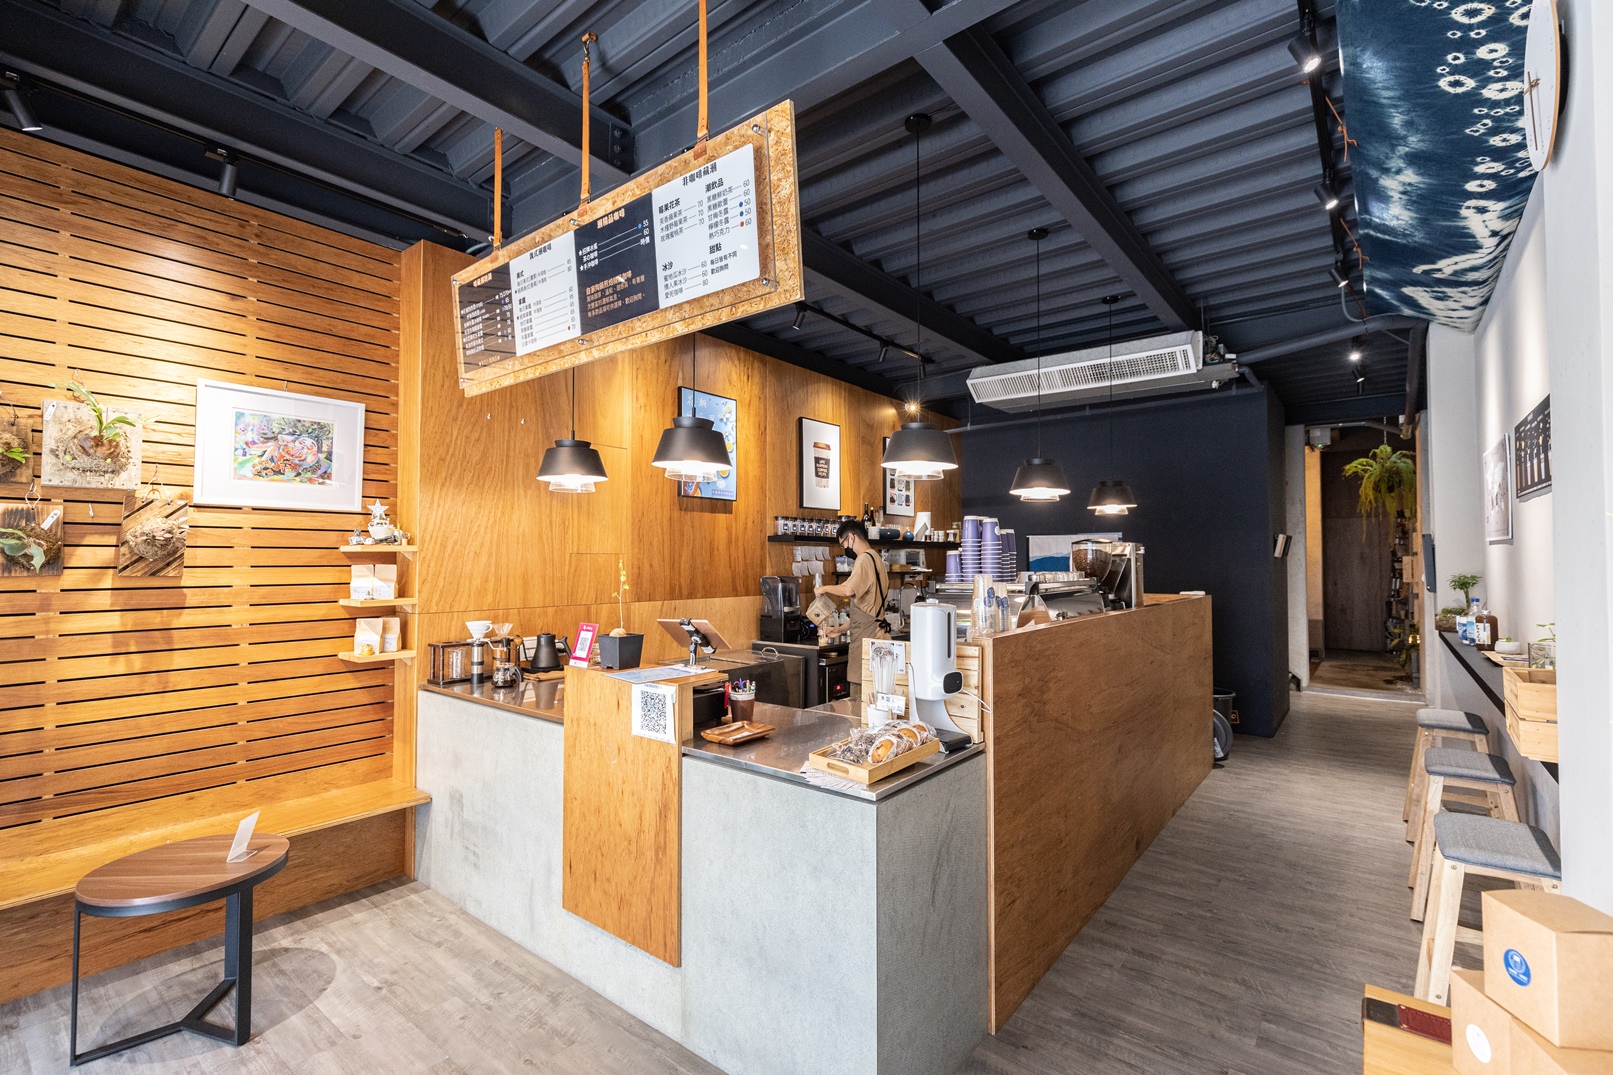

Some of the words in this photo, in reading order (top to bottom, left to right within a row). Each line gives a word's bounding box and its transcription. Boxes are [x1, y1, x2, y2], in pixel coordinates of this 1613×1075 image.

[706, 186, 734, 204] 黑糖鮮奶茶
[743, 178, 750, 188] 60
[697, 200, 704, 208] 70
[708, 198, 728, 212] 黑糖歐蕾
[744, 188, 750, 197] 60
[744, 198, 751, 206] 50
[698, 208, 704, 216] 70
[745, 207, 752, 216] 50
[642, 219, 649, 228] 55
[698, 218, 704, 226] 70
[644, 228, 650, 236] 60
[709, 226, 730, 240] 熱巧克力
[745, 218, 752, 226] 60
[709, 242, 722, 254] 甜點
[710, 250, 738, 266] 每日皆有不同
[662, 260, 674, 272] 冰沙
[700, 260, 708, 268] 60
[710, 263, 729, 275] 歡迎詢問
[702, 270, 708, 278] 60
[702, 278, 708, 286] 80
